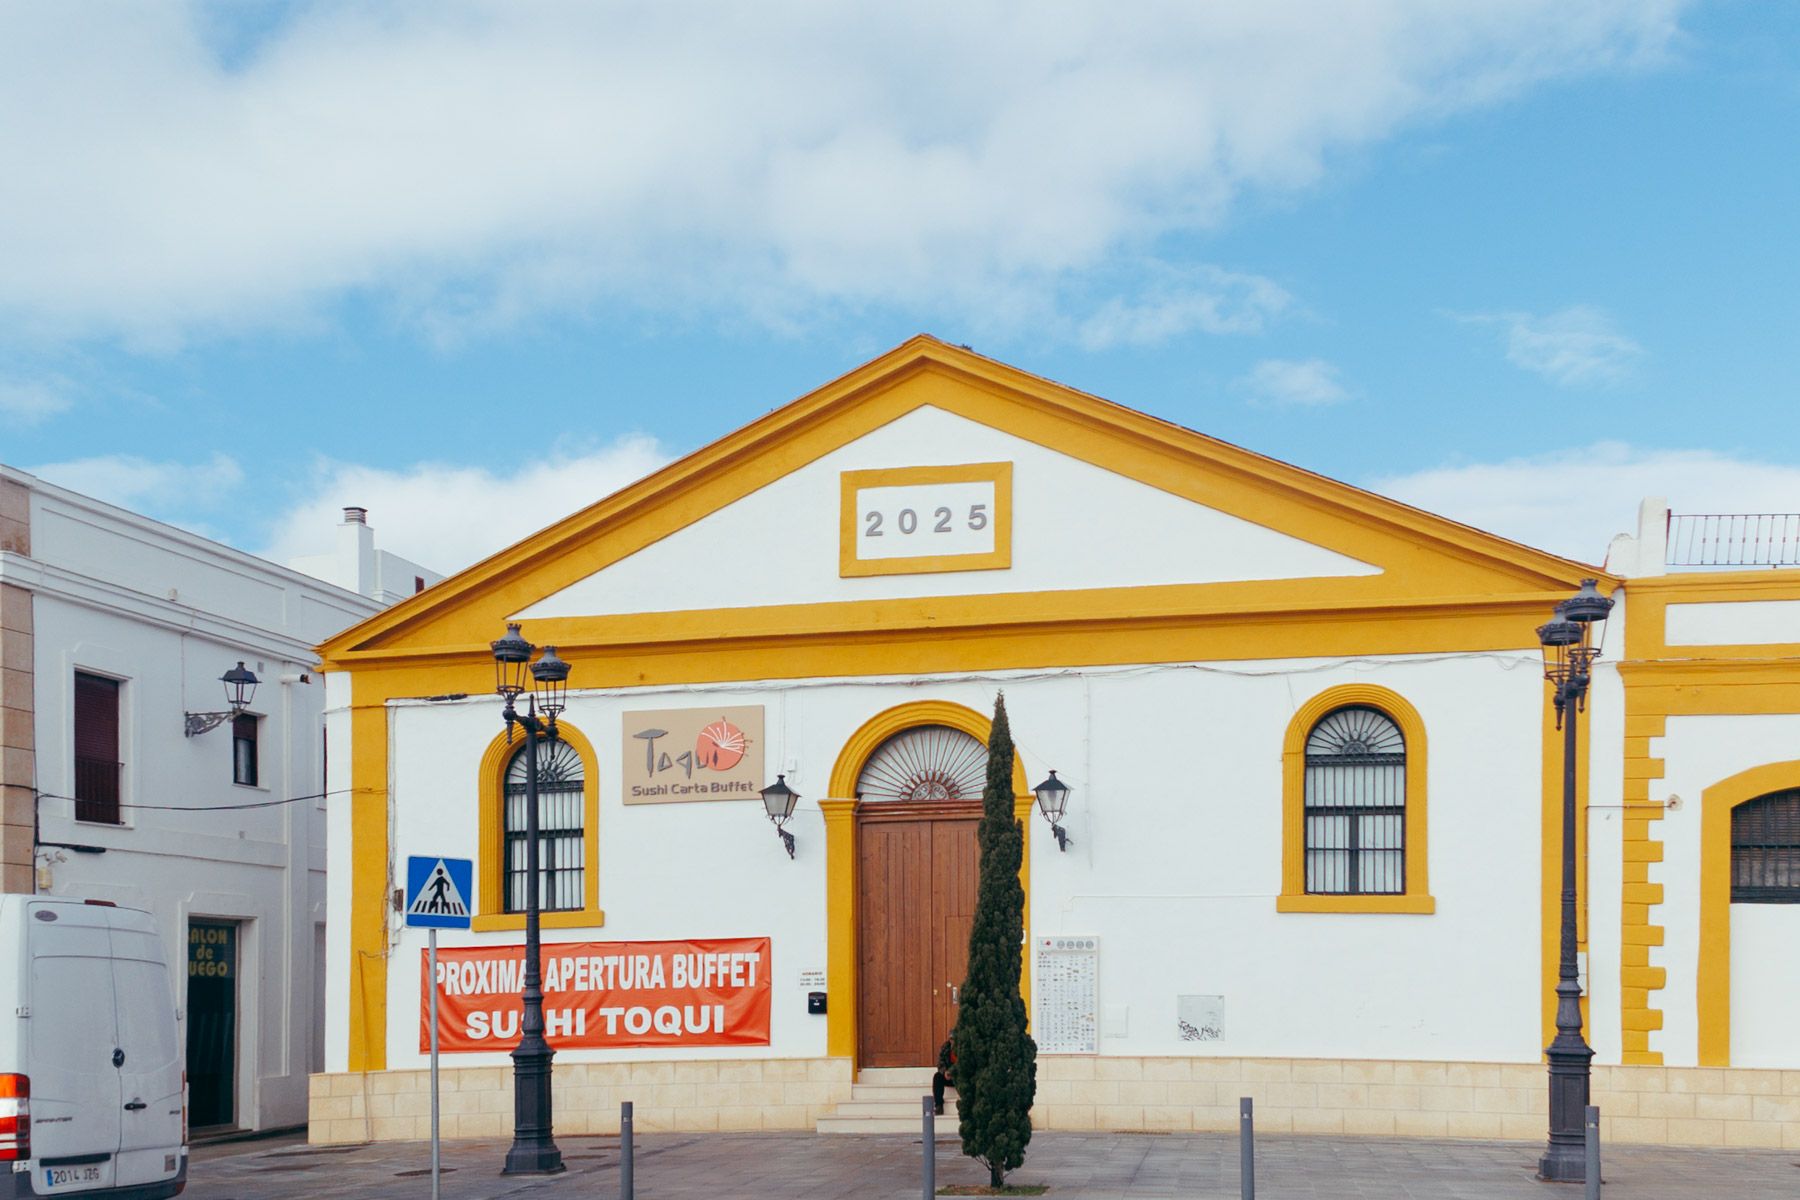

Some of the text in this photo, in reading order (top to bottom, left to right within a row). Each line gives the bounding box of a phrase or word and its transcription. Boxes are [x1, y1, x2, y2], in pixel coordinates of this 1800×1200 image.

[865, 504, 988, 537] 2025
[632, 781, 754, 796] Sushi Carta Buffet
[188, 928, 228, 944] ALON
[196, 944, 214, 960] de
[188, 960, 228, 977] UEGO
[544, 954, 666, 992] APERTURA
[672, 952, 760, 989] BUFFET
[465, 1005, 725, 1040] SUHI TOQUI
